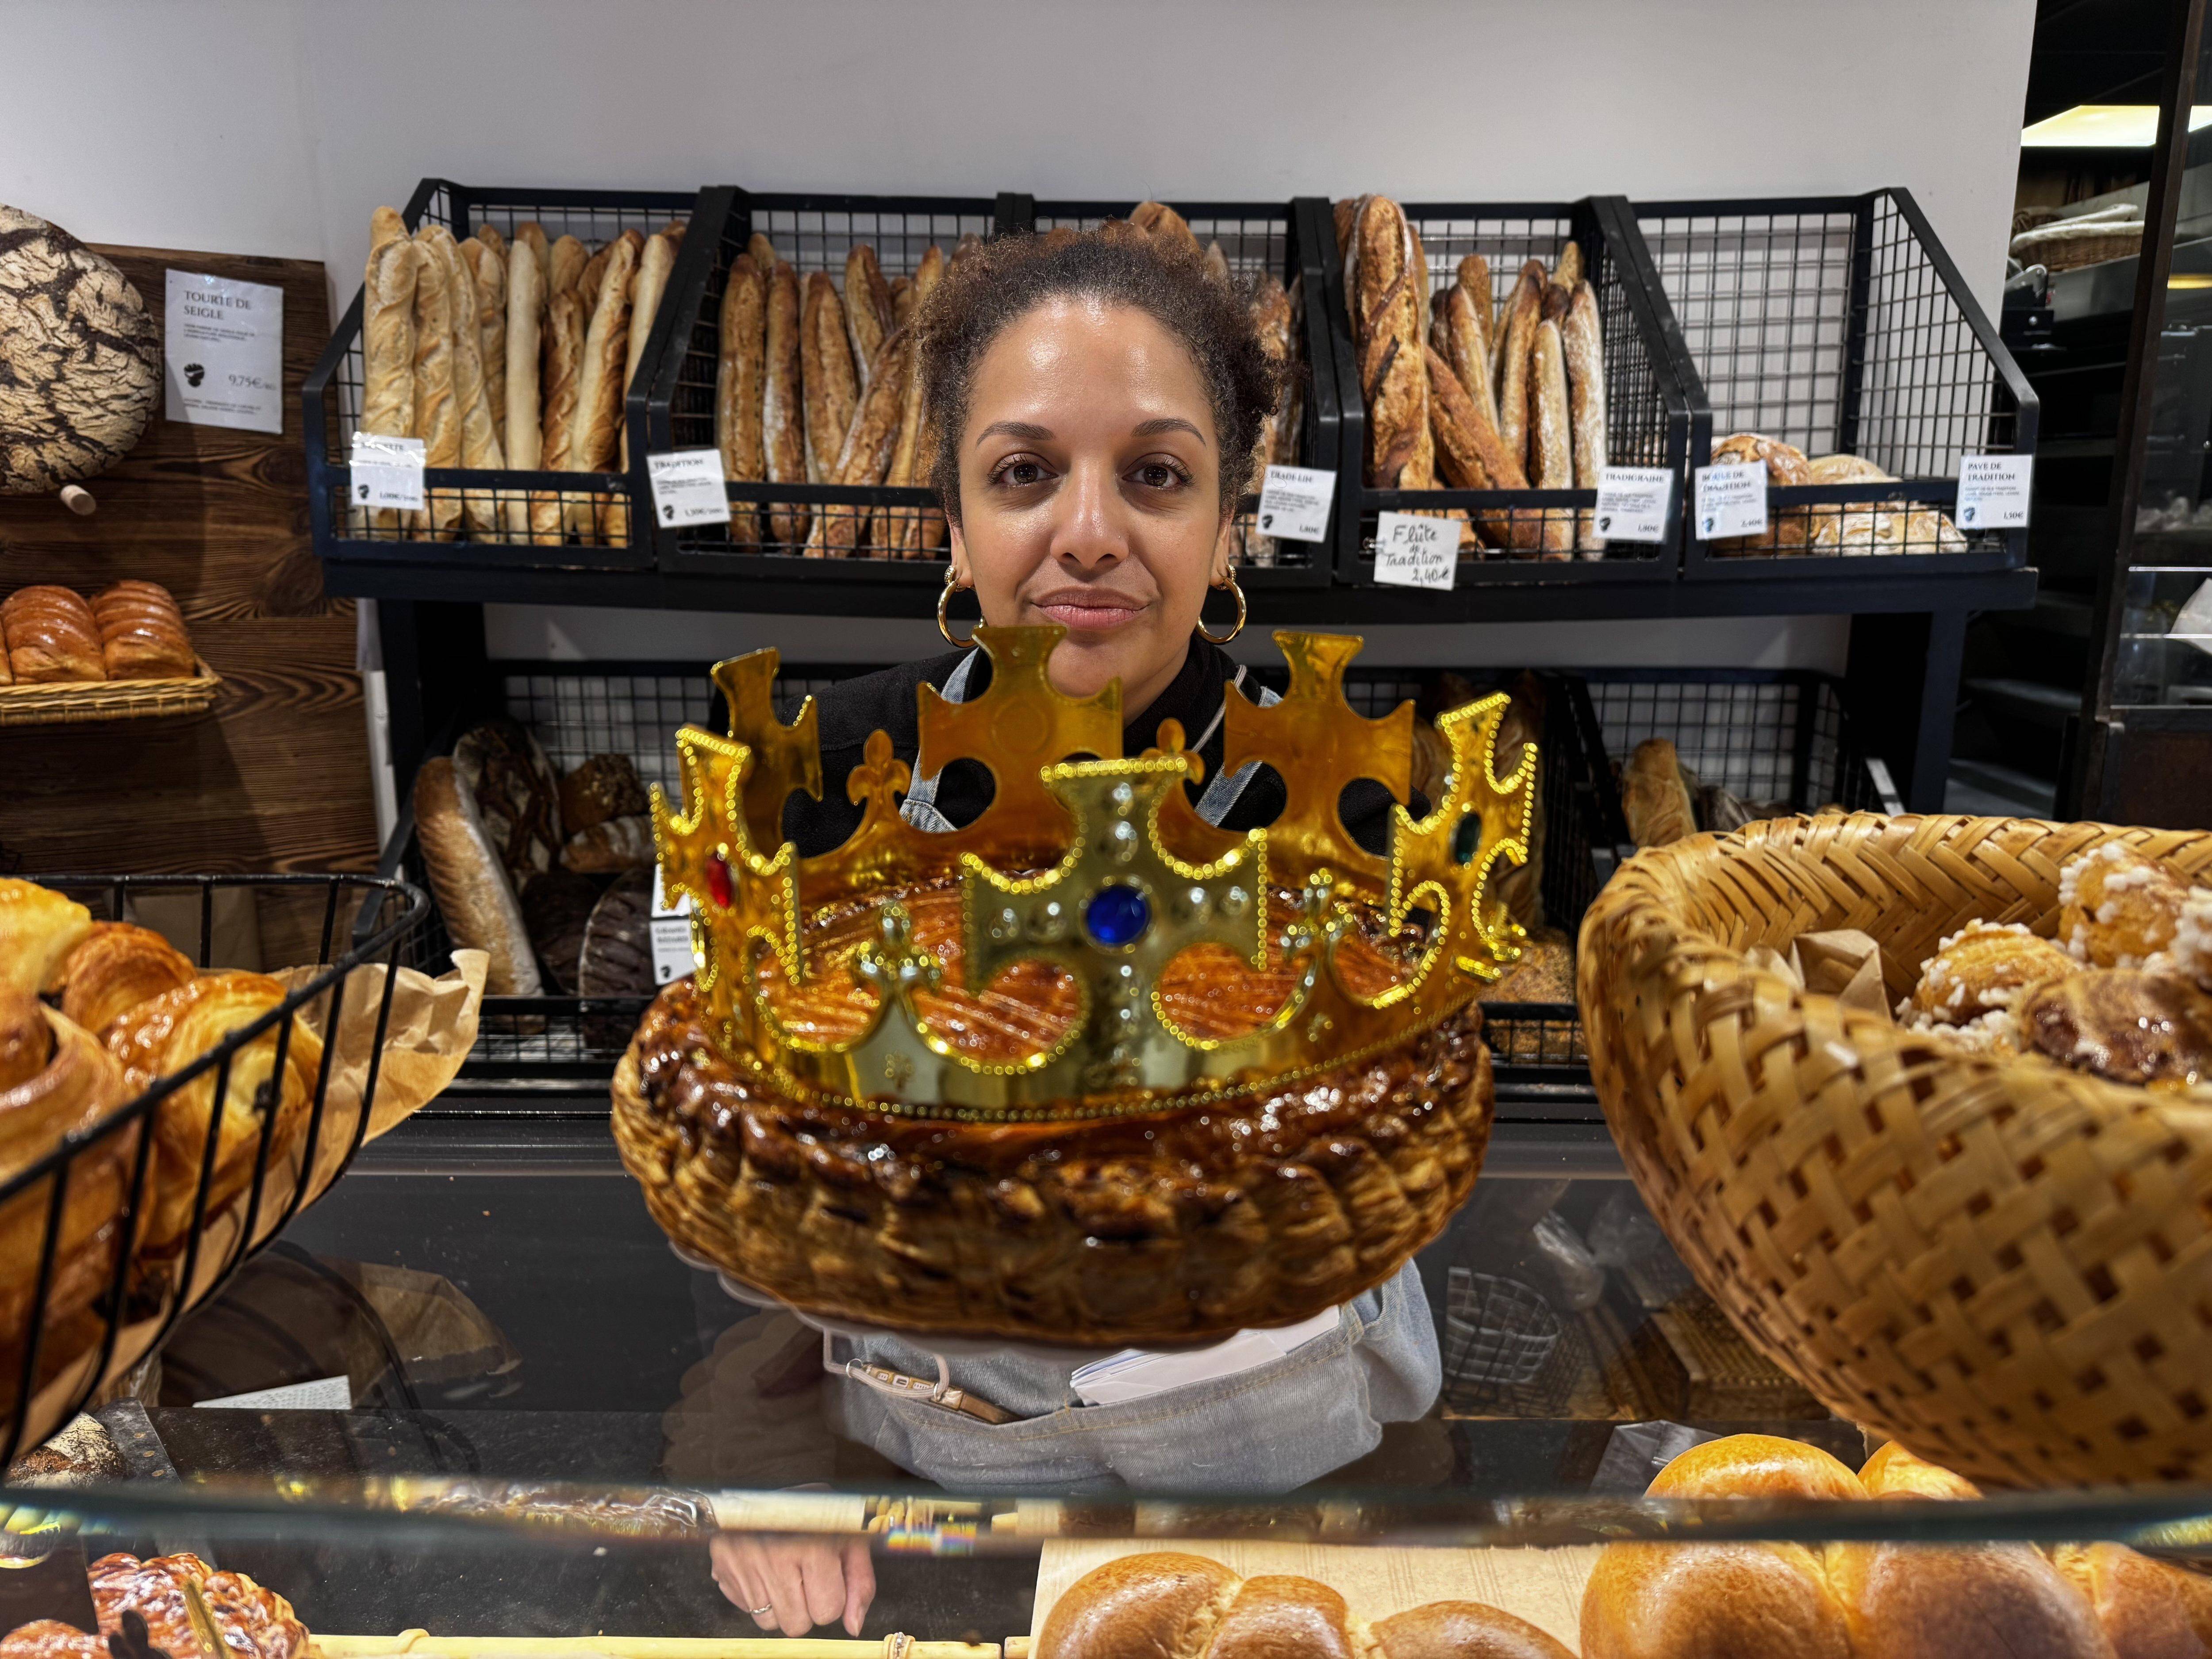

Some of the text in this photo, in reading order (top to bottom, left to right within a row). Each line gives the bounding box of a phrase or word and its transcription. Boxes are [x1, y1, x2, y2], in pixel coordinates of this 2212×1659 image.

[184, 290, 251, 310] TOURTE DE
[184, 305, 224, 321] SEIGLE
[1990, 461, 2001, 470] DE
[1605, 473, 1663, 483] TRADIGRAINE
[1968, 472, 2015, 481] TRADITION
[1393, 524, 1436, 544] Flûte
[1385, 548, 1442, 567] Tradition
